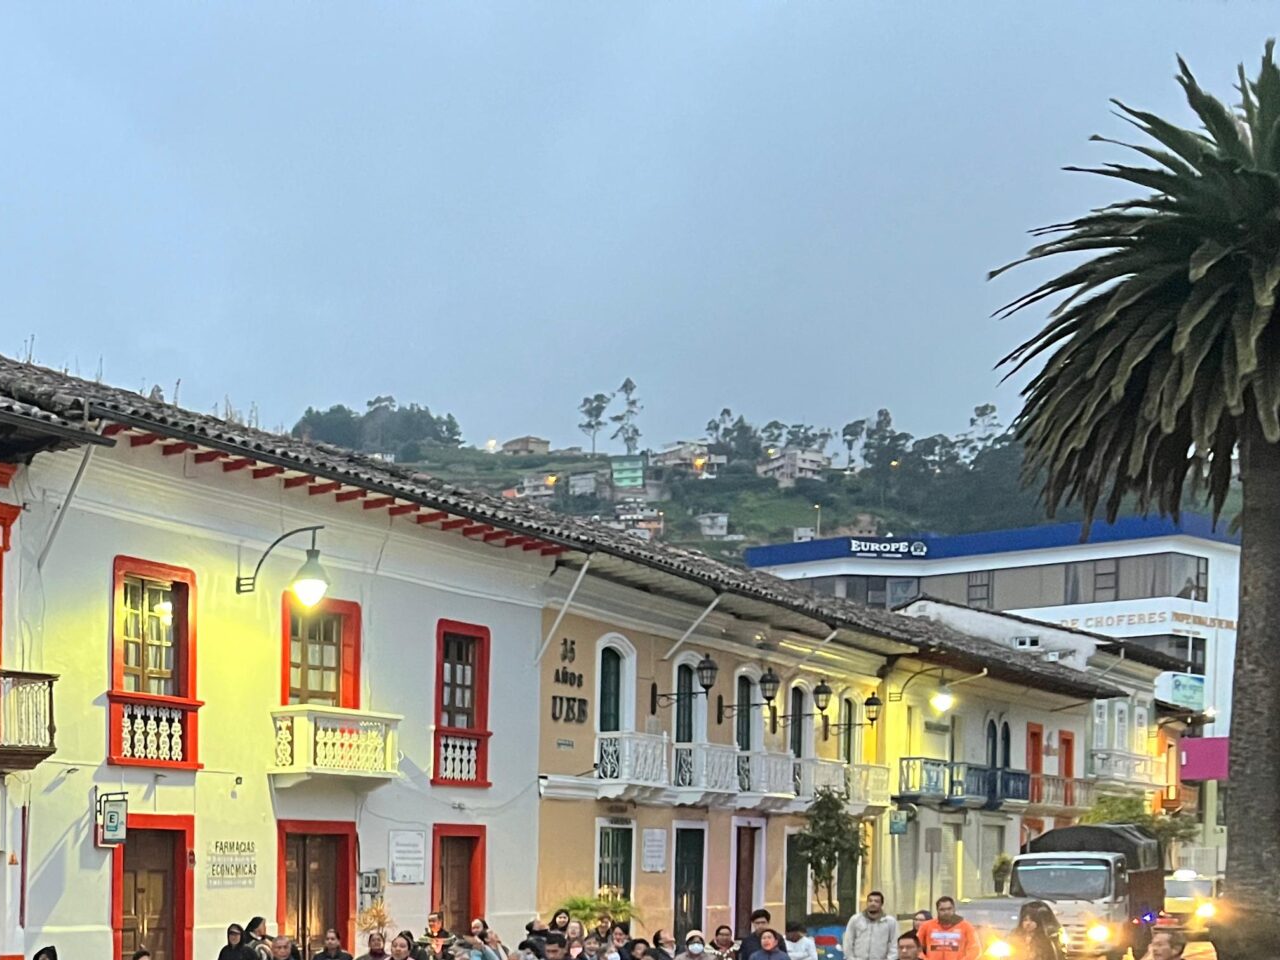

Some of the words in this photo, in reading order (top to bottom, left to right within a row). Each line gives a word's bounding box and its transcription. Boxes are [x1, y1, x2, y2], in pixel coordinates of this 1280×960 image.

[851, 540, 909, 552] EUROPE
[1085, 611, 1167, 628] CHOFERES
[554, 666, 584, 688] AÑOS
[551, 695, 589, 723] UEB
[215, 841, 256, 854] FARMACIAS
